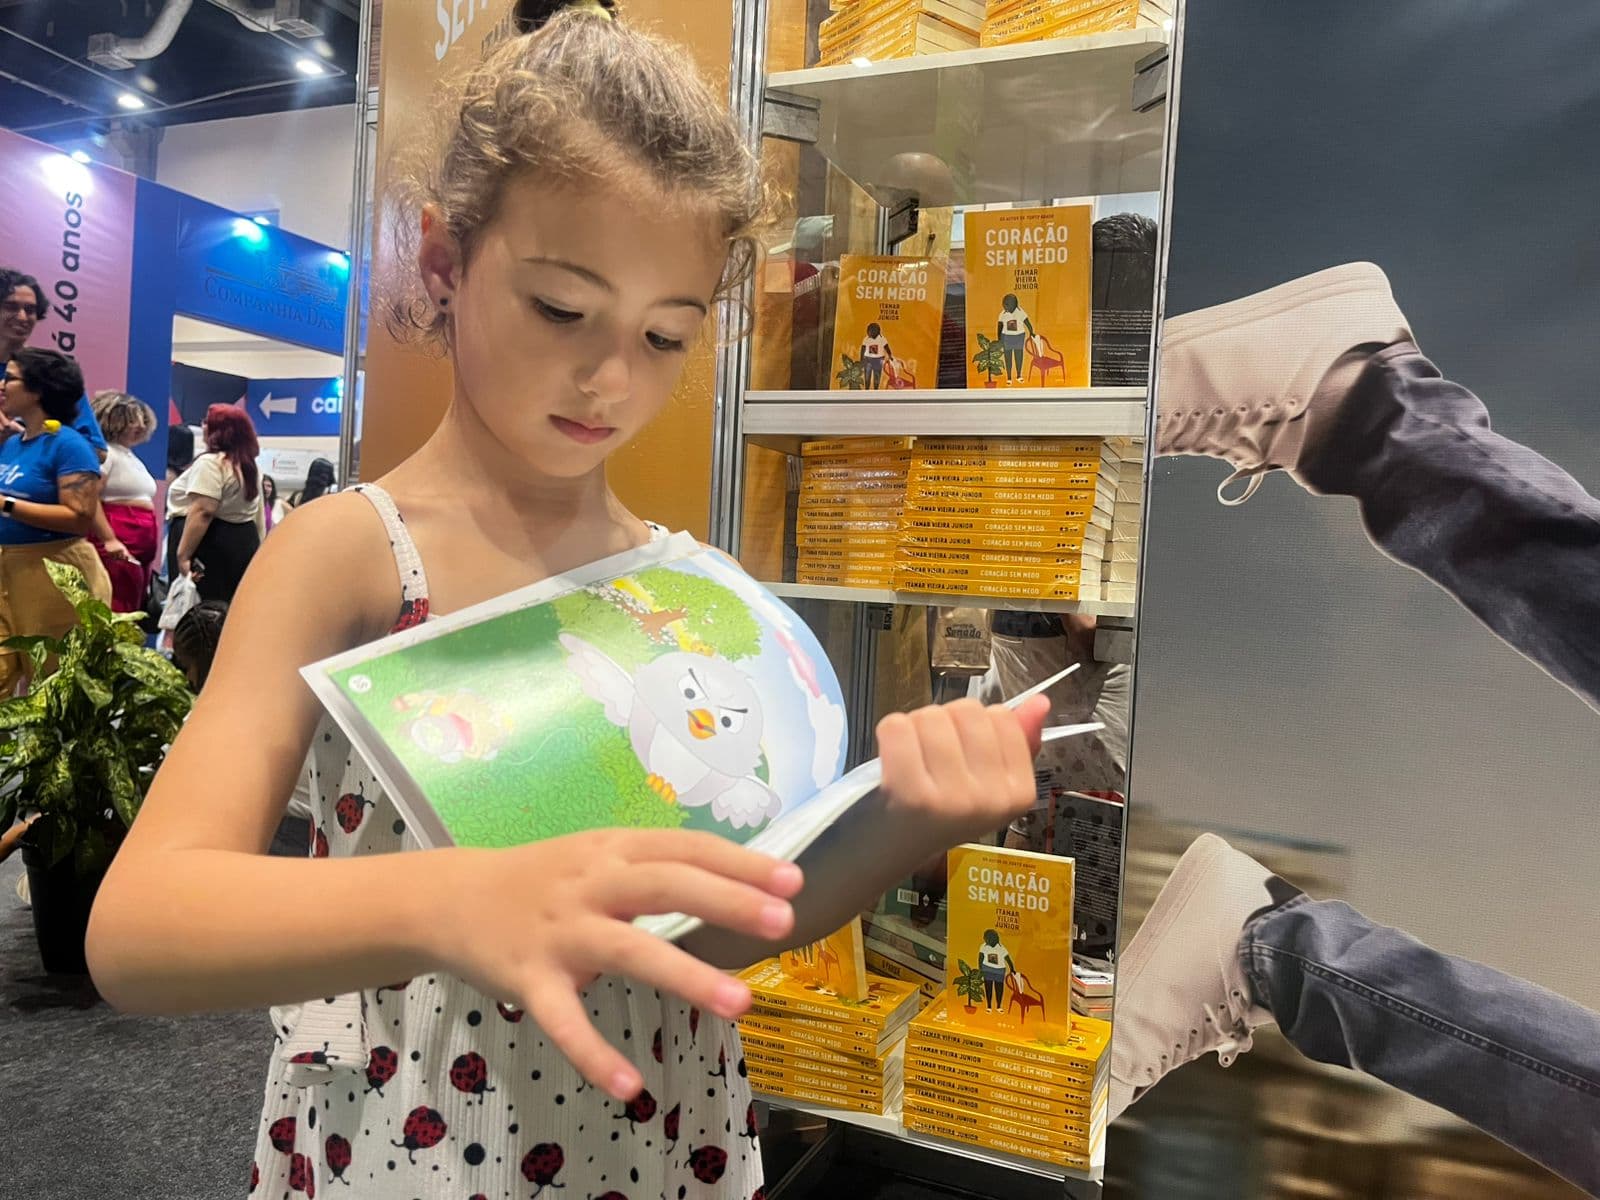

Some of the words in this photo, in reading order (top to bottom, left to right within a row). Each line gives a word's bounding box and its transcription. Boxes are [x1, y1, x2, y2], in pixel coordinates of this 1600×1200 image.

[62, 191, 82, 272] anos
[986, 222, 1068, 247] CORAÇÃO
[986, 249, 1018, 266] SEM
[1022, 247, 1068, 265] MEDO
[54, 280, 78, 323] 40
[856, 286, 884, 300] SEM
[887, 287, 926, 302] MEDO
[968, 866, 1050, 893] CORAÇÃO
[968, 885, 999, 904] SEM
[1004, 890, 1050, 912] MEDO
[996, 908, 1020, 917] ITAMAR
[995, 922, 1020, 930] JUNIOR
